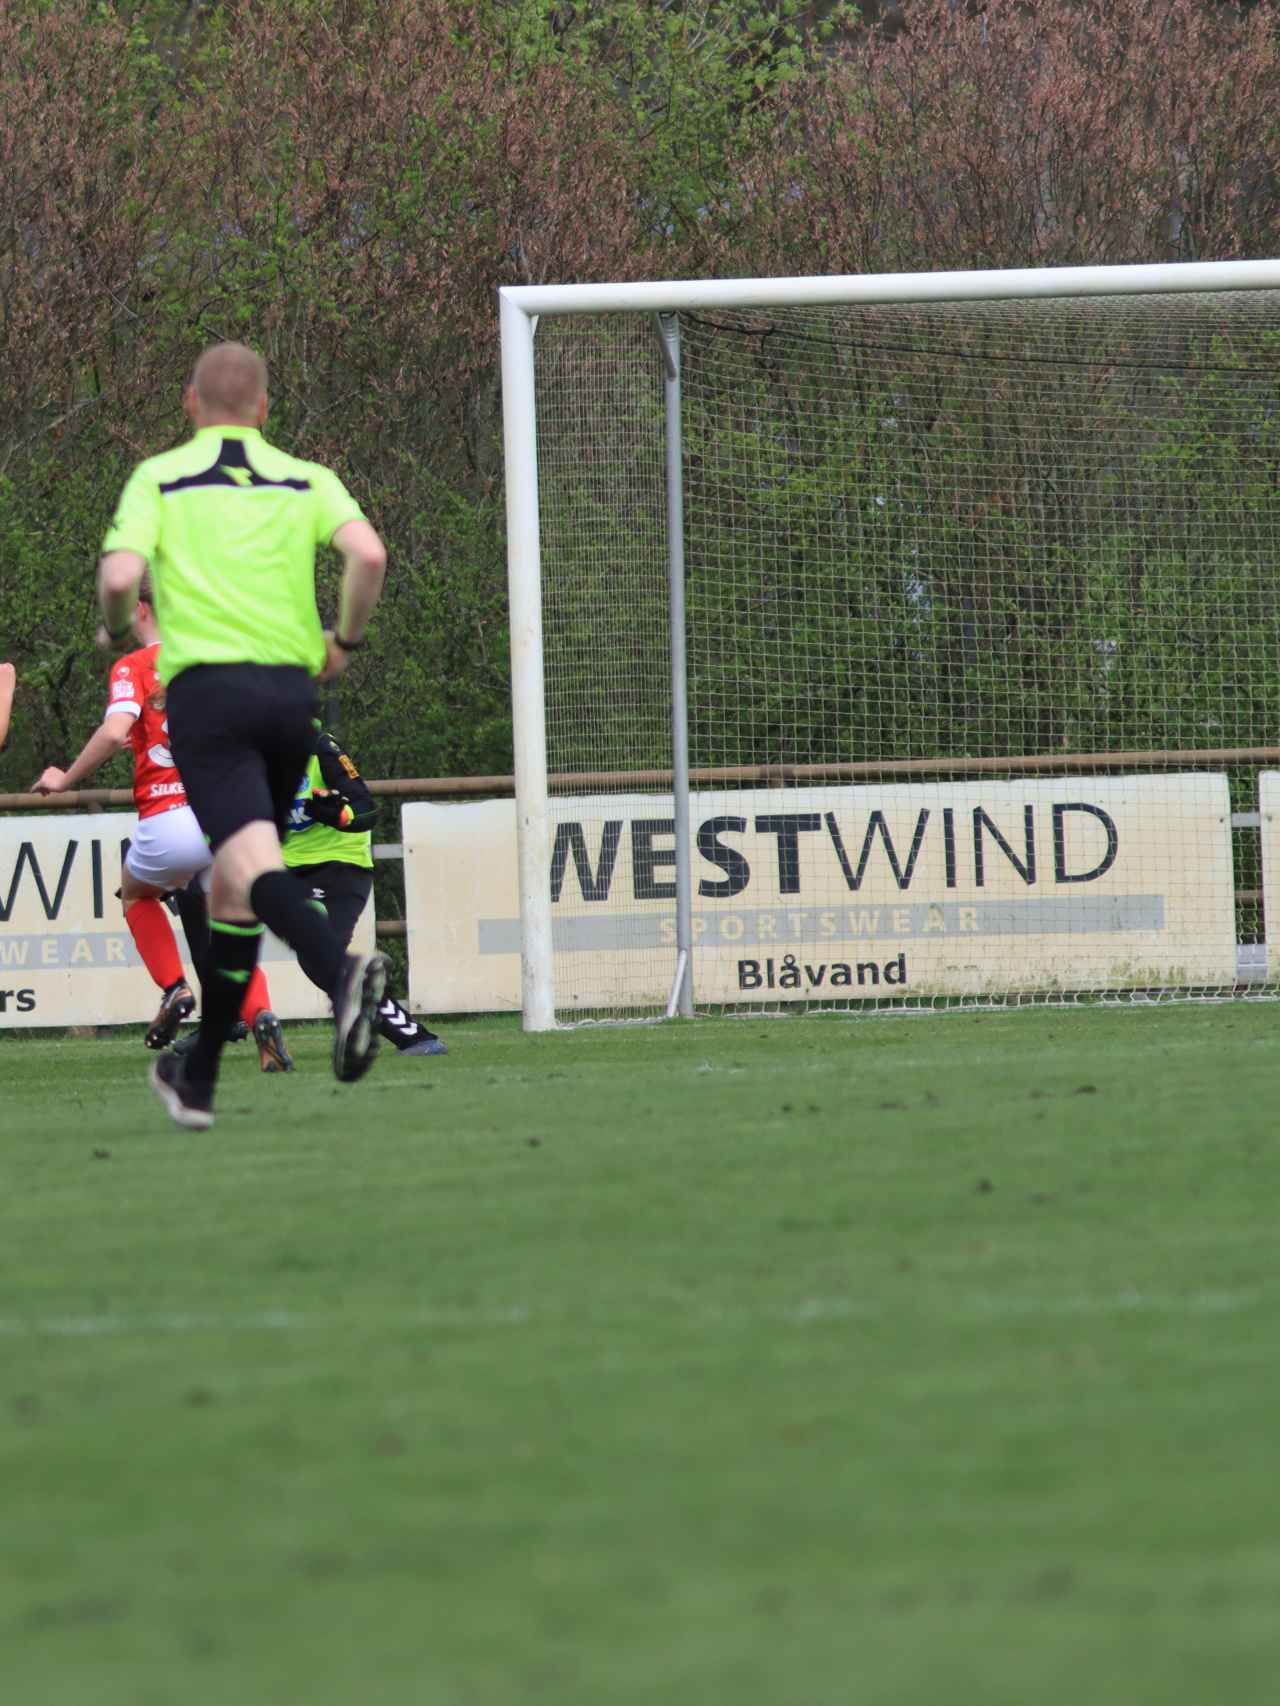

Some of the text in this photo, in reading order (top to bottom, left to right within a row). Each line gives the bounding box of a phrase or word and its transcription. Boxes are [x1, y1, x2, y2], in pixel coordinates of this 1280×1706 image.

[549, 802, 1119, 902] WESTWIND
[659, 906, 978, 945] SPORTSWEAR
[738, 953, 907, 991] Blåvand
